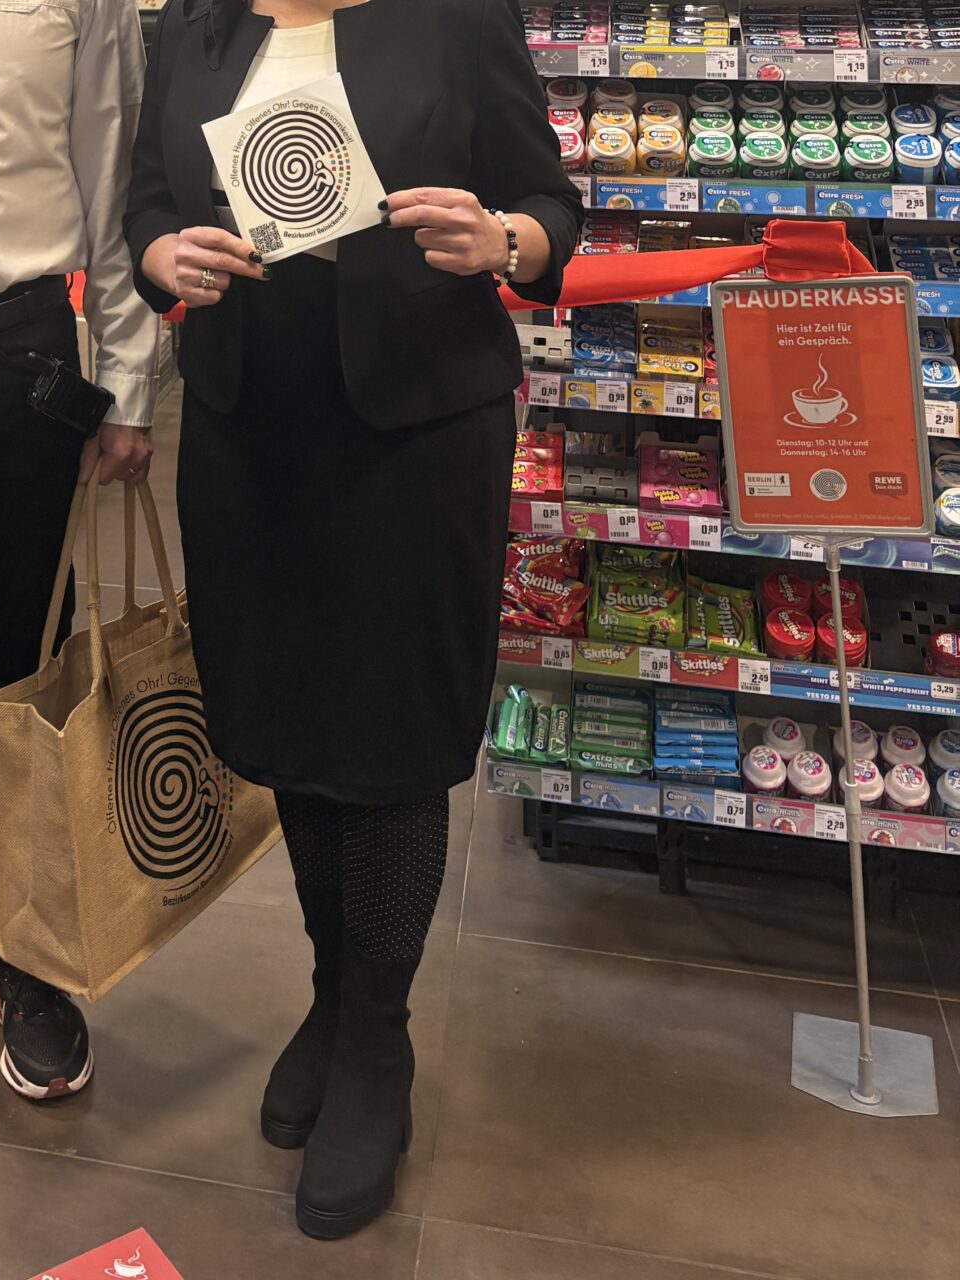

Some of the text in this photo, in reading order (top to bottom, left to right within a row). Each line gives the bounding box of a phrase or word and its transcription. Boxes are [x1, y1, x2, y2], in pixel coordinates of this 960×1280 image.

[644, 54, 666, 62] WHITE
[772, 56, 794, 64] WHITE
[906, 58, 930, 66] WHITE
[244, 108, 272, 132] Offenes
[272, 100, 290, 112] Ohr!
[292, 99, 319, 112] Gegen
[319, 106, 355, 145] Einsamkeit!
[283, 229, 317, 240] Bezirksamt
[721, 286, 907, 310] PLAUDERKASSE
[776, 322, 852, 334] Hier ist Zeit für
[778, 334, 852, 348] ein Gespräch.
[776, 438, 869, 450] Dienstag: 10-12 Uhr und
[780, 448, 868, 458] Donnerstag: 14-16 Uhr
[746, 476, 773, 484] BERLIN
[874, 476, 902, 484] REWE
[518, 571, 571, 598] Skittles
[605, 592, 669, 608] Skittles
[498, 638, 537, 650] Skittles
[584, 648, 627, 660] Skittles
[680, 658, 725, 672] Skittles
[810, 676, 828, 684] MINT
[862, 683, 884, 691] WHITE
[884, 686, 930, 696] PEPPERMINT
[932, 705, 956, 714] FRESH
[106, 776, 114, 834] Offenes
[136, 674, 164, 694] Ohr!
